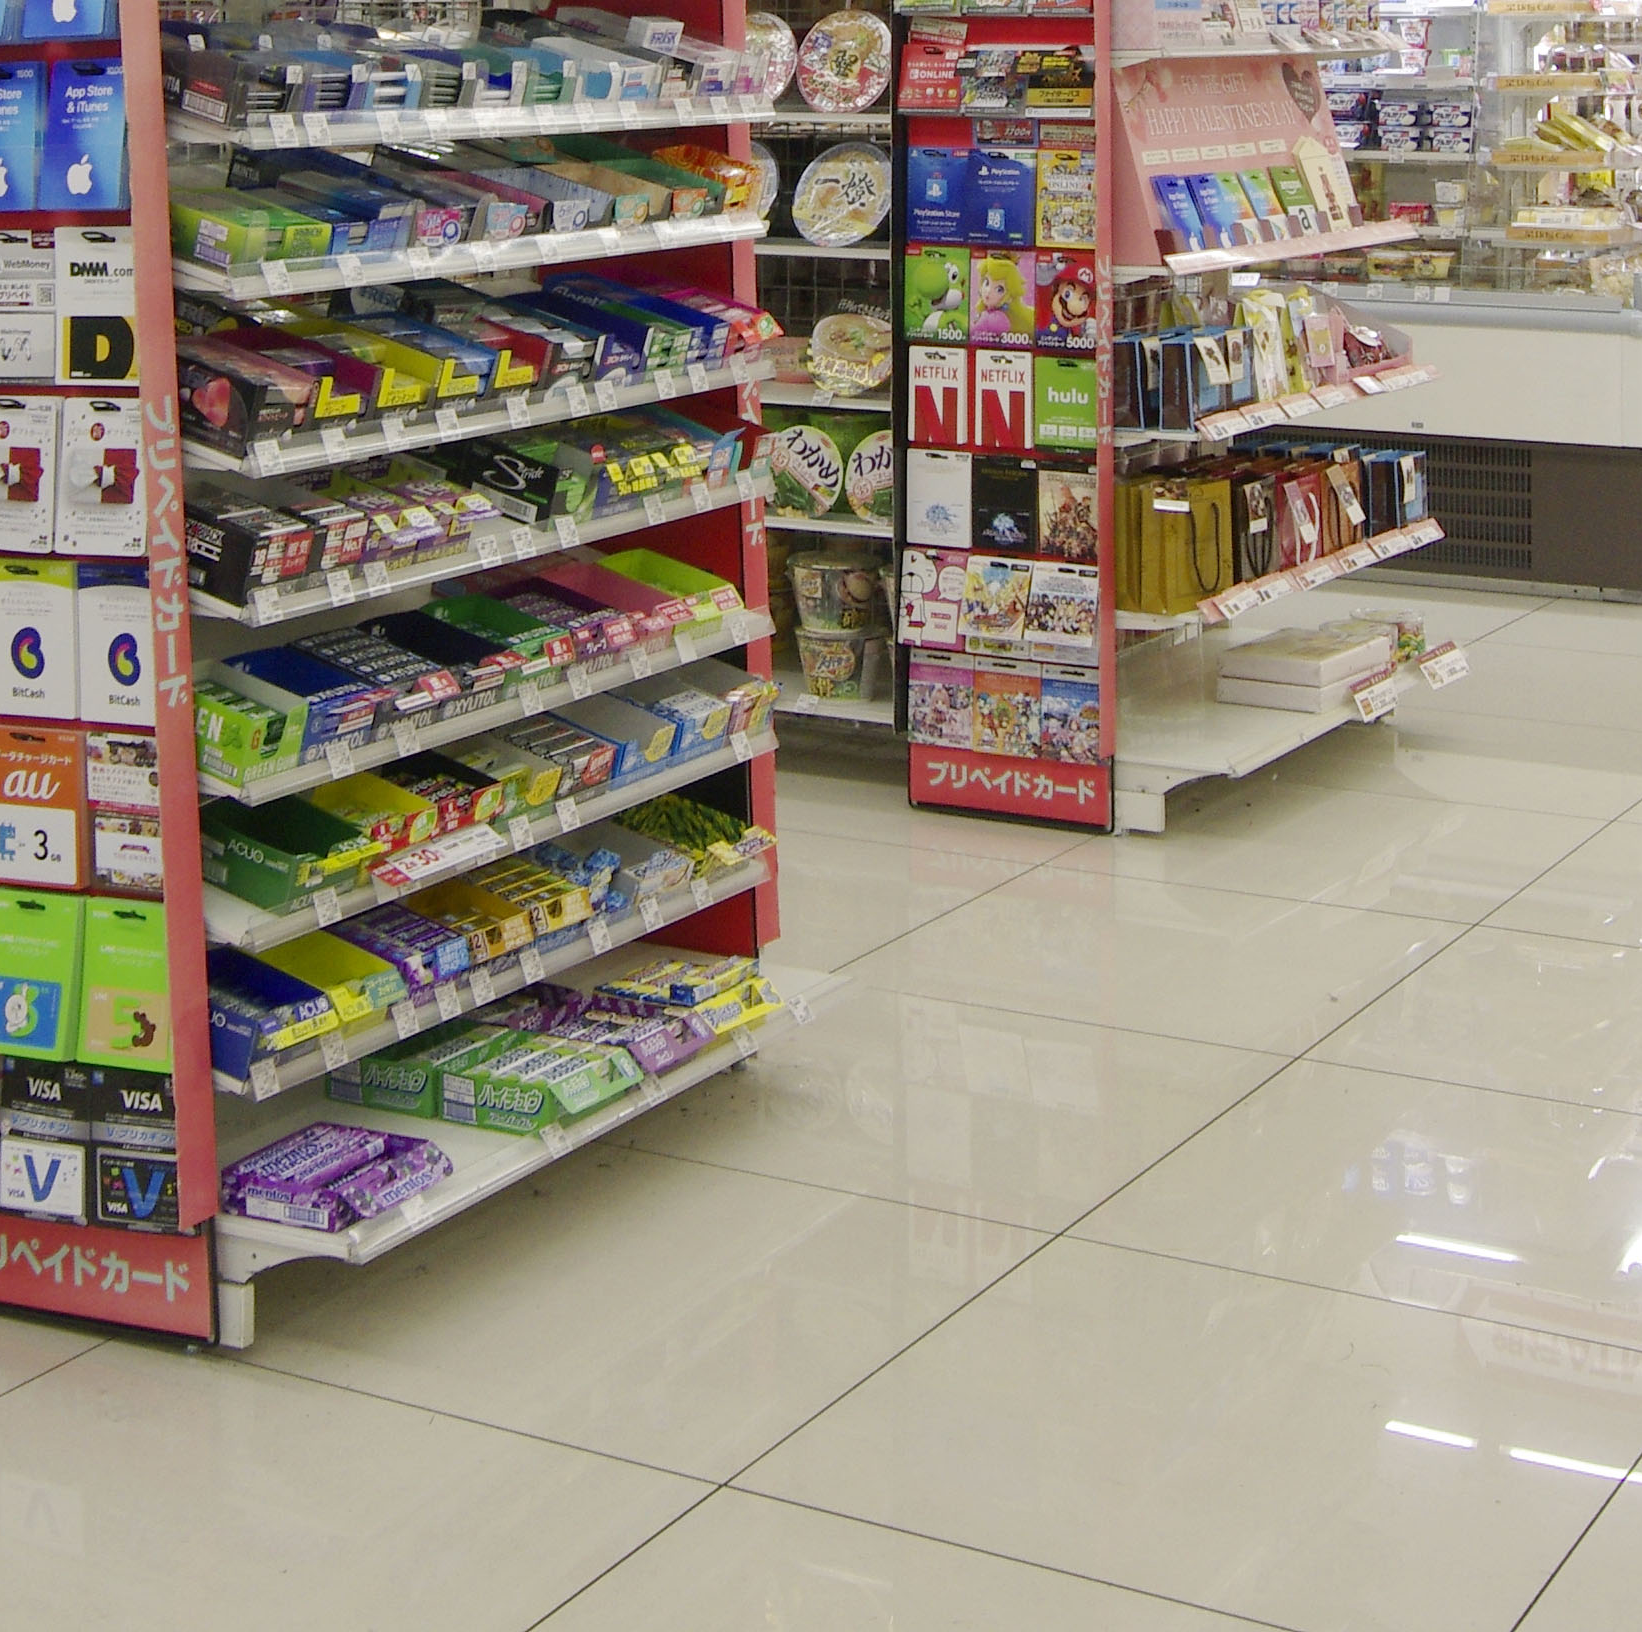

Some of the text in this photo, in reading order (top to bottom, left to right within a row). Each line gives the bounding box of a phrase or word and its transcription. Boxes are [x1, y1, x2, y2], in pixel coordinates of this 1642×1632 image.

[649, 29, 680, 48] FRISK
[919, 69, 955, 79] ONLINE
[1221, 71, 1248, 93] GIFT
[64, 84, 113, 102] App Store
[66, 98, 109, 114] & iTunes
[1145, 107, 1189, 136] HAPPY
[1299, 207, 1312, 231] a
[3, 258, 52, 270] WebMoney
[936, 328, 963, 341] 1500
[1000, 332, 1030, 345] 3000
[1066, 337, 1095, 349] 5000
[914, 364, 959, 381] NETFLIX
[980, 368, 1026, 385] NETFLIX
[1046, 386, 1090, 406] hulu
[914, 385, 959, 443] N
[980, 388, 1026, 449] N
[786, 425, 841, 490] わかめ
[145, 394, 188, 709] プリペイドカード
[12, 686, 46, 700] BitCash
[108, 693, 141, 707] BitCash
[3, 769, 61, 801] au
[926, 761, 1096, 806] プリペイドカード
[33, 829, 49, 861] 3
[227, 839, 265, 864] ACUO
[26, 1076, 62, 1102] VISA
[364, 1065, 428, 1094] ハイチュウ
[120, 1089, 164, 1113] VISA
[477, 1083, 544, 1115] ハイチュウ
[23, 1154, 62, 1203] V
[382, 1169, 434, 1206] mentos
[122, 1165, 168, 1219] V
[247, 1185, 291, 1202] mentos
[107, 1201, 128, 1215] VISA
